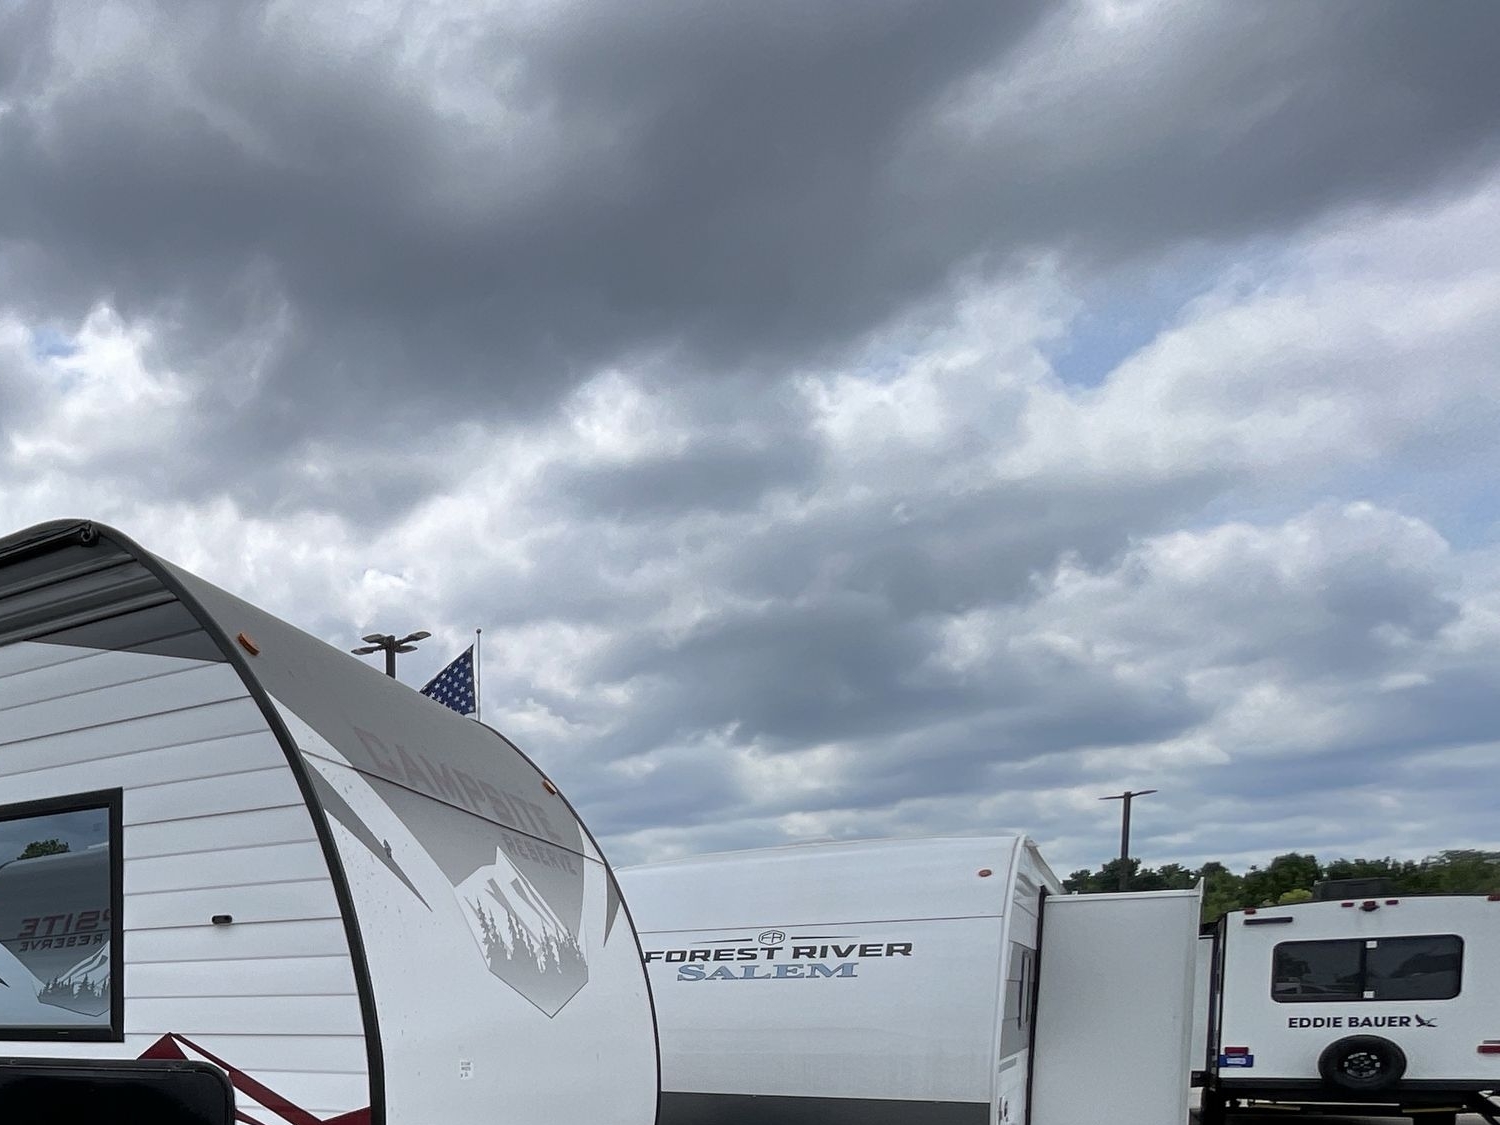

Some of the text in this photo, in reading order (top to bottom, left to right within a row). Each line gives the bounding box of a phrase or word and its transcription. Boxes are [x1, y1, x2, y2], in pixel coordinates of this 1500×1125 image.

[644, 942, 913, 964] FOREST RIVER
[676, 962, 859, 982] SALEM
[1288, 1015, 1411, 1028] EDDIE BAUER
